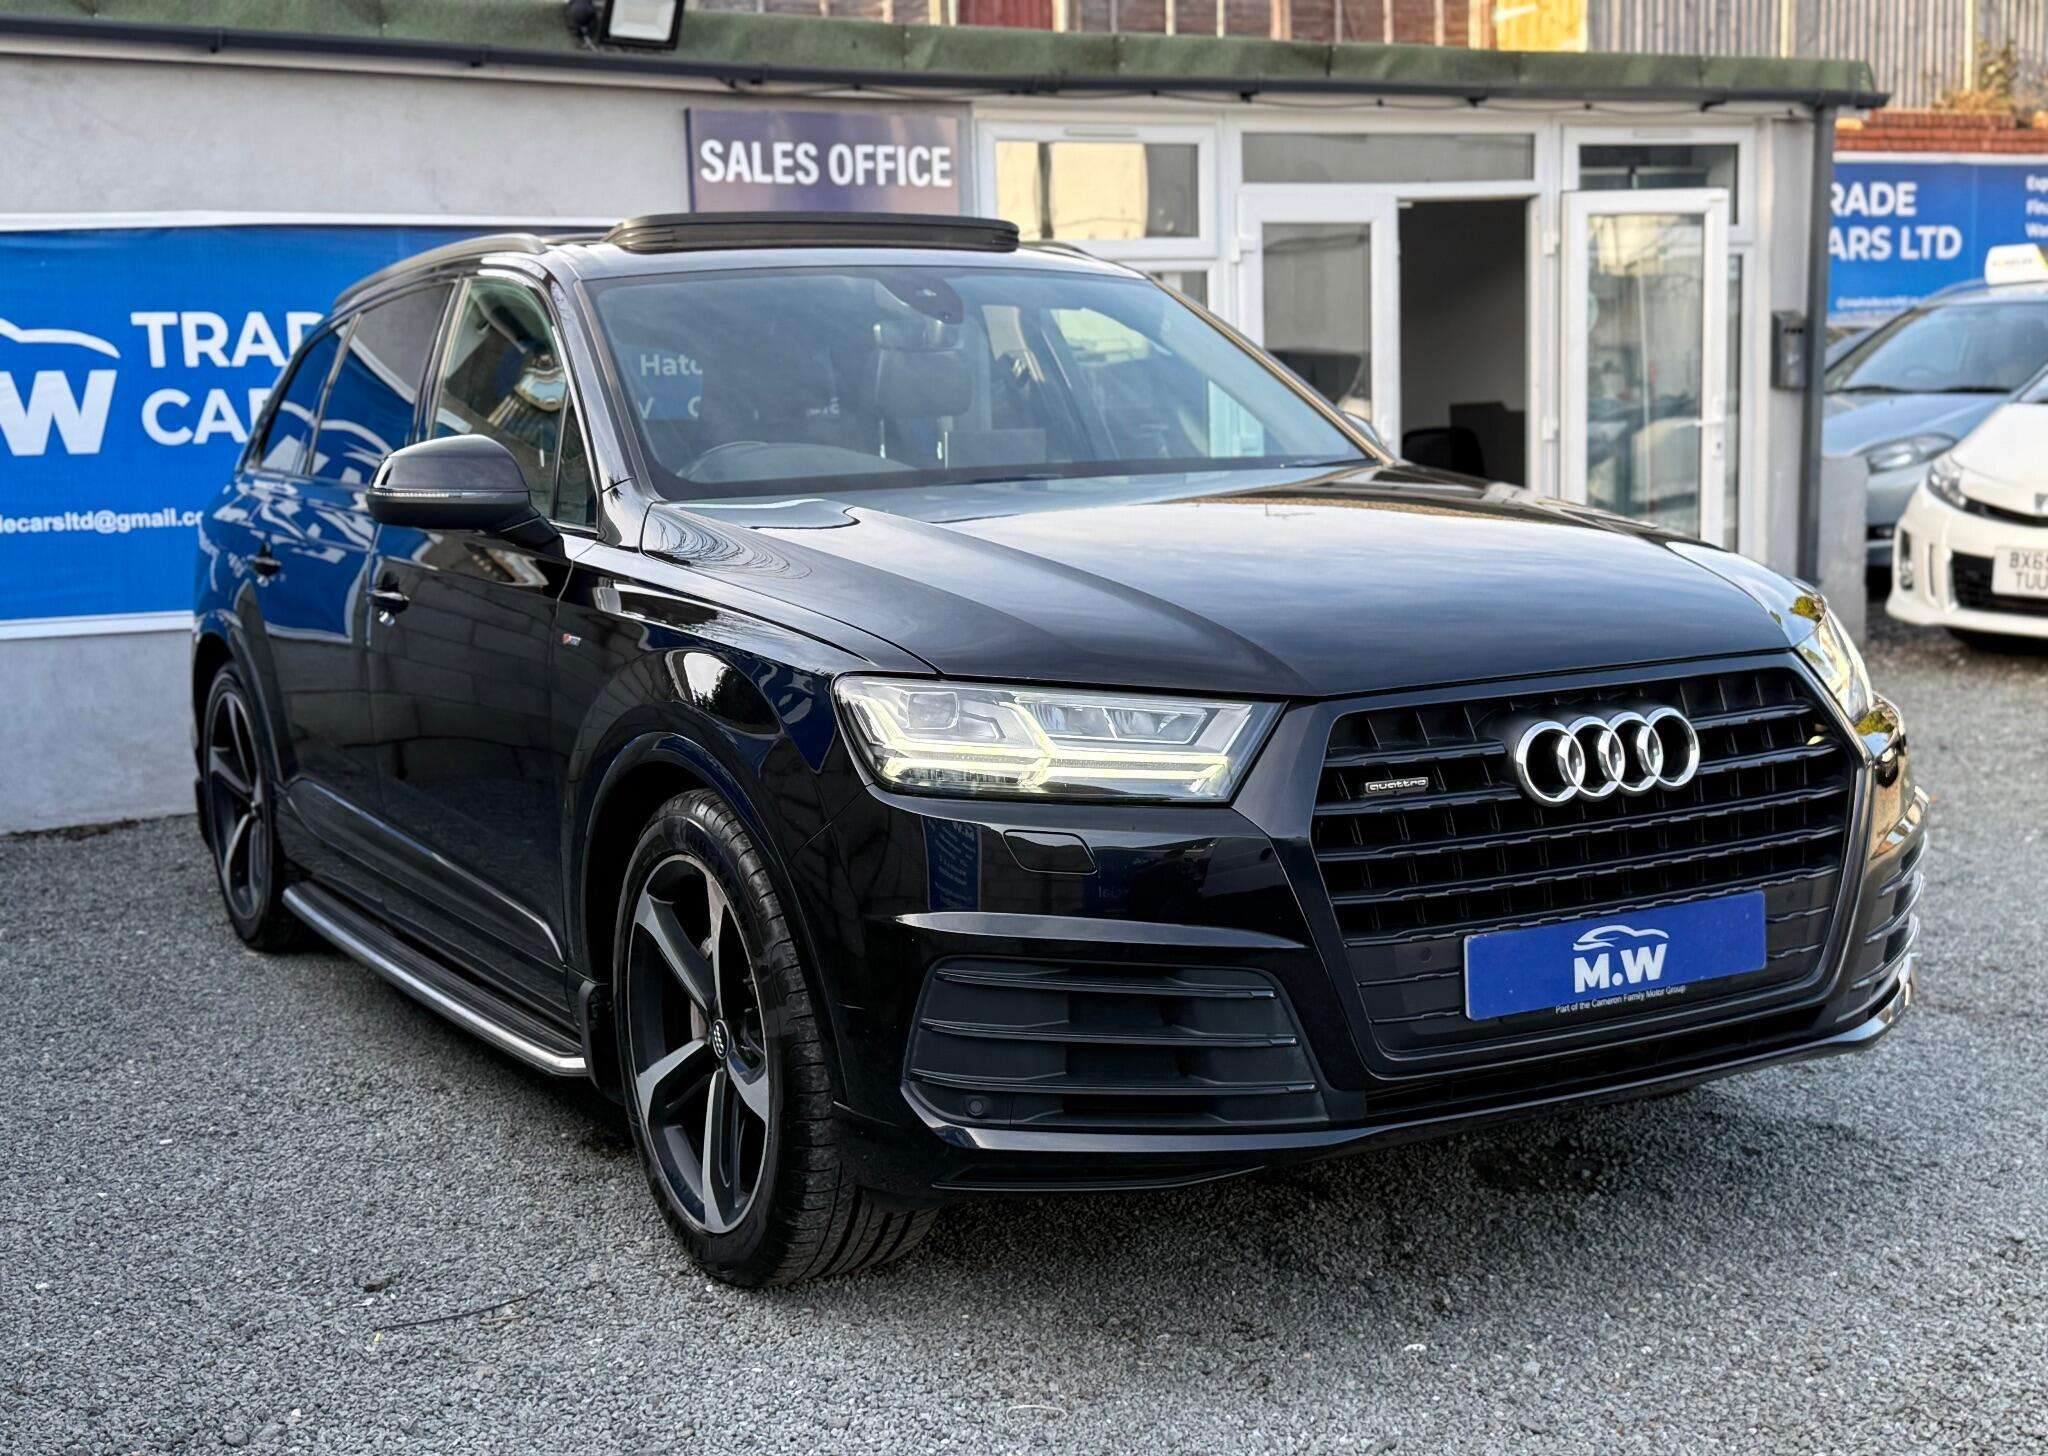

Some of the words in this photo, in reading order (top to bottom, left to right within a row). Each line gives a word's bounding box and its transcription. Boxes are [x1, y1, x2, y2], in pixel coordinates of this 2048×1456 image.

[701, 139, 819, 185] SALES
[828, 143, 953, 187] OFFICE
[1828, 225, 1893, 261] ARS
[1900, 225, 1963, 260] LTD
[2010, 551, 2048, 570] BX6
[1369, 779, 1427, 791] quattro
[1573, 943, 1668, 993] M.W
[1555, 1004, 1571, 1014] Part
[1571, 1002, 1578, 1011] of
[1579, 1001, 1591, 1010] the
[1591, 995, 1622, 1008] Cameron
[1623, 992, 1645, 1003] Family
[1646, 988, 1665, 999] Motor
